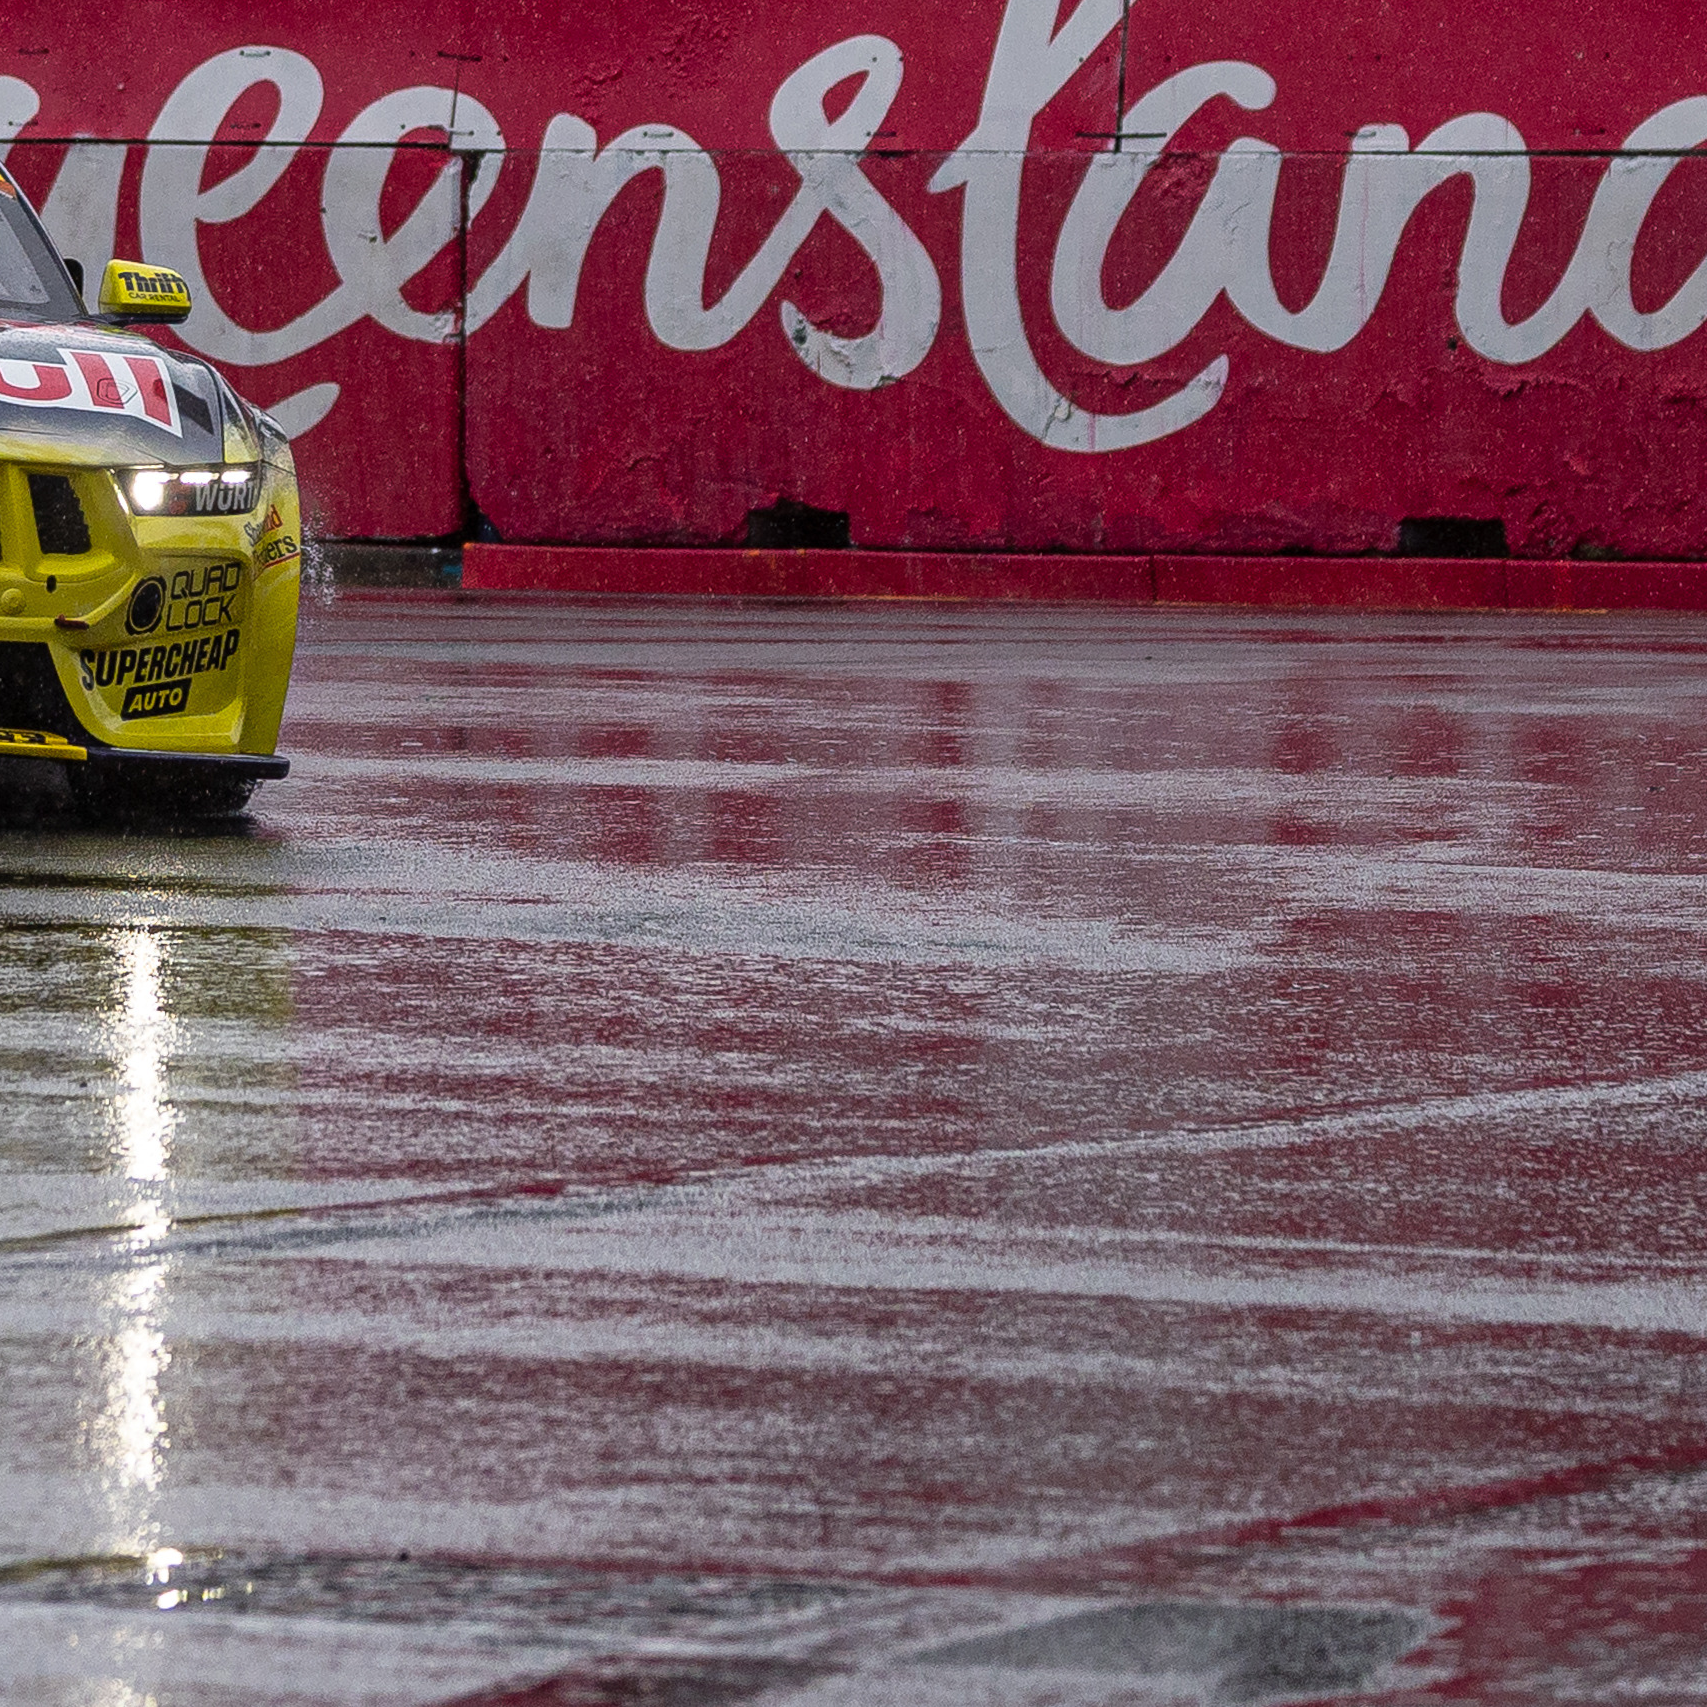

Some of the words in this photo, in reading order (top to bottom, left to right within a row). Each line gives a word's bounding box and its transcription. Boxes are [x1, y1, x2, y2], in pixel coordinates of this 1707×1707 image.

[171, 562, 241, 599] QUAD
[166, 594, 235, 631] LOCK
[79, 629, 239, 691] SUPERCHEAP
[129, 688, 182, 712] AUTO
